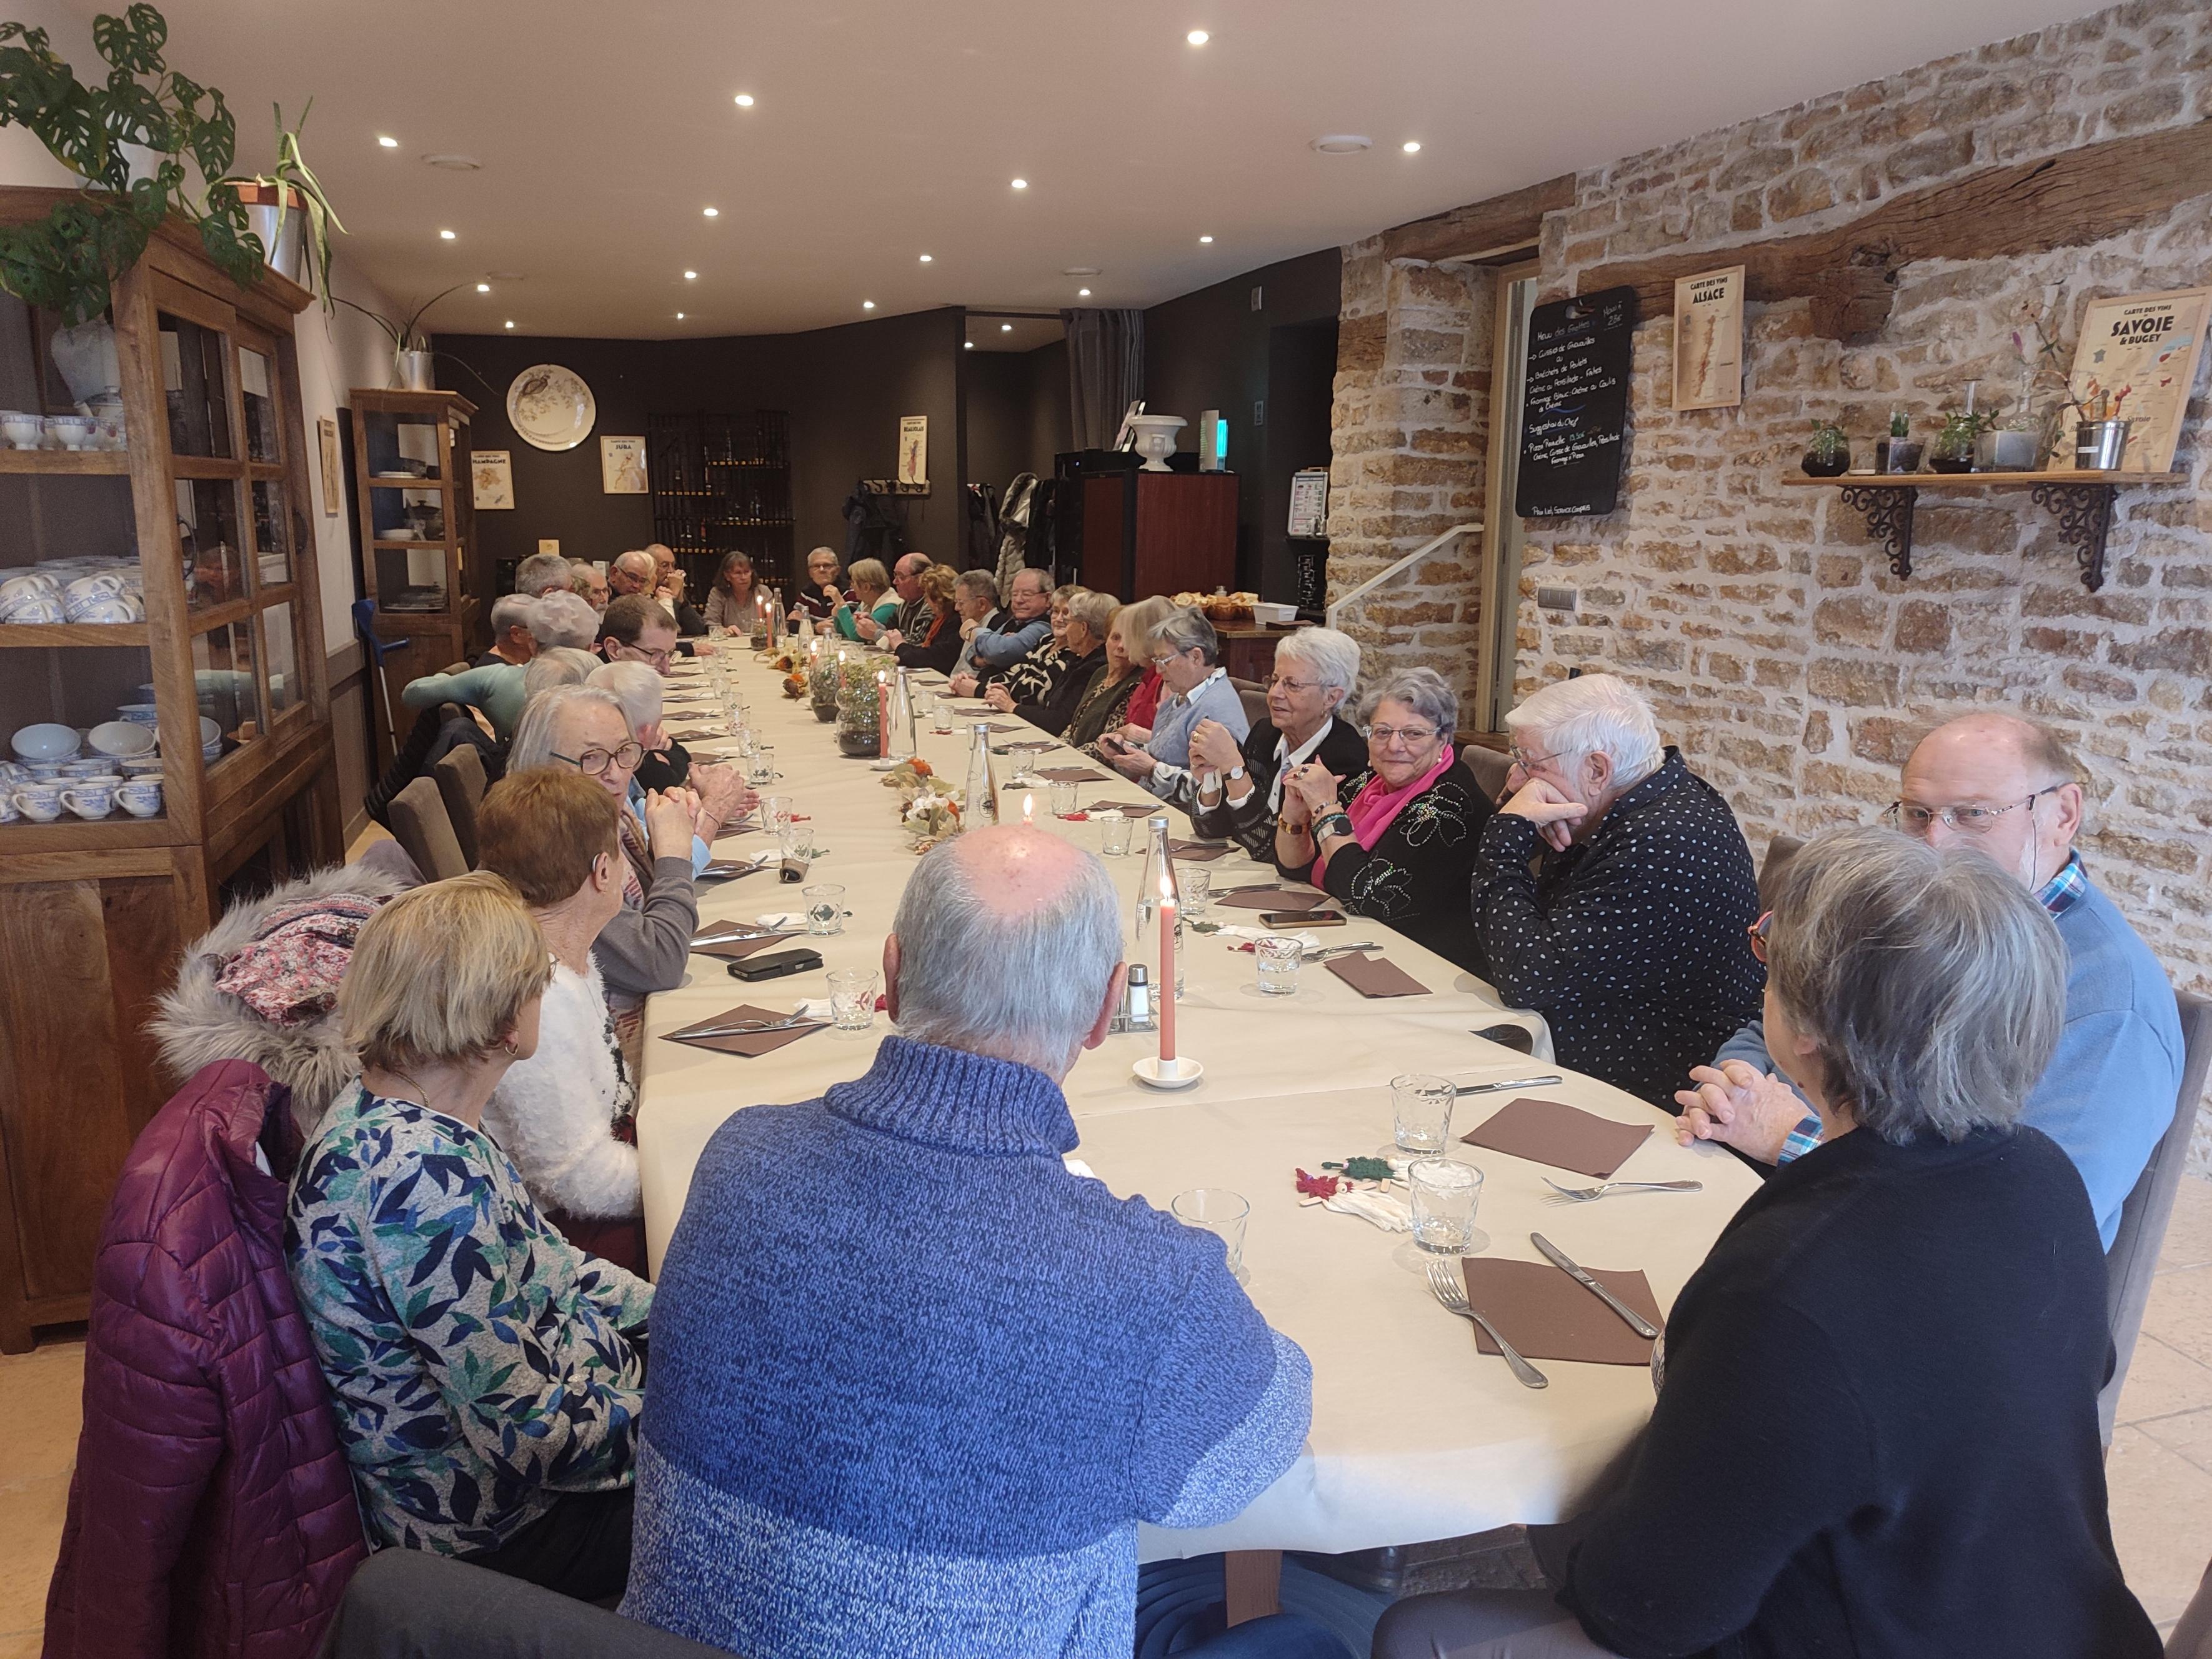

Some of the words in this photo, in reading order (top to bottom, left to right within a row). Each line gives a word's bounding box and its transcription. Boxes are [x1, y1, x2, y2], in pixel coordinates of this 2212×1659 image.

[1690, 281, 1705, 290] CARTE
[1706, 279, 1715, 287] DES
[1716, 276, 1728, 284] VINS
[1693, 287, 1725, 304] ALSACE
[2124, 307, 2143, 316] CARTE
[2110, 316, 2175, 337] SAVOIE
[2120, 337, 2128, 345] &
[2128, 333, 2162, 344] BUGEY
